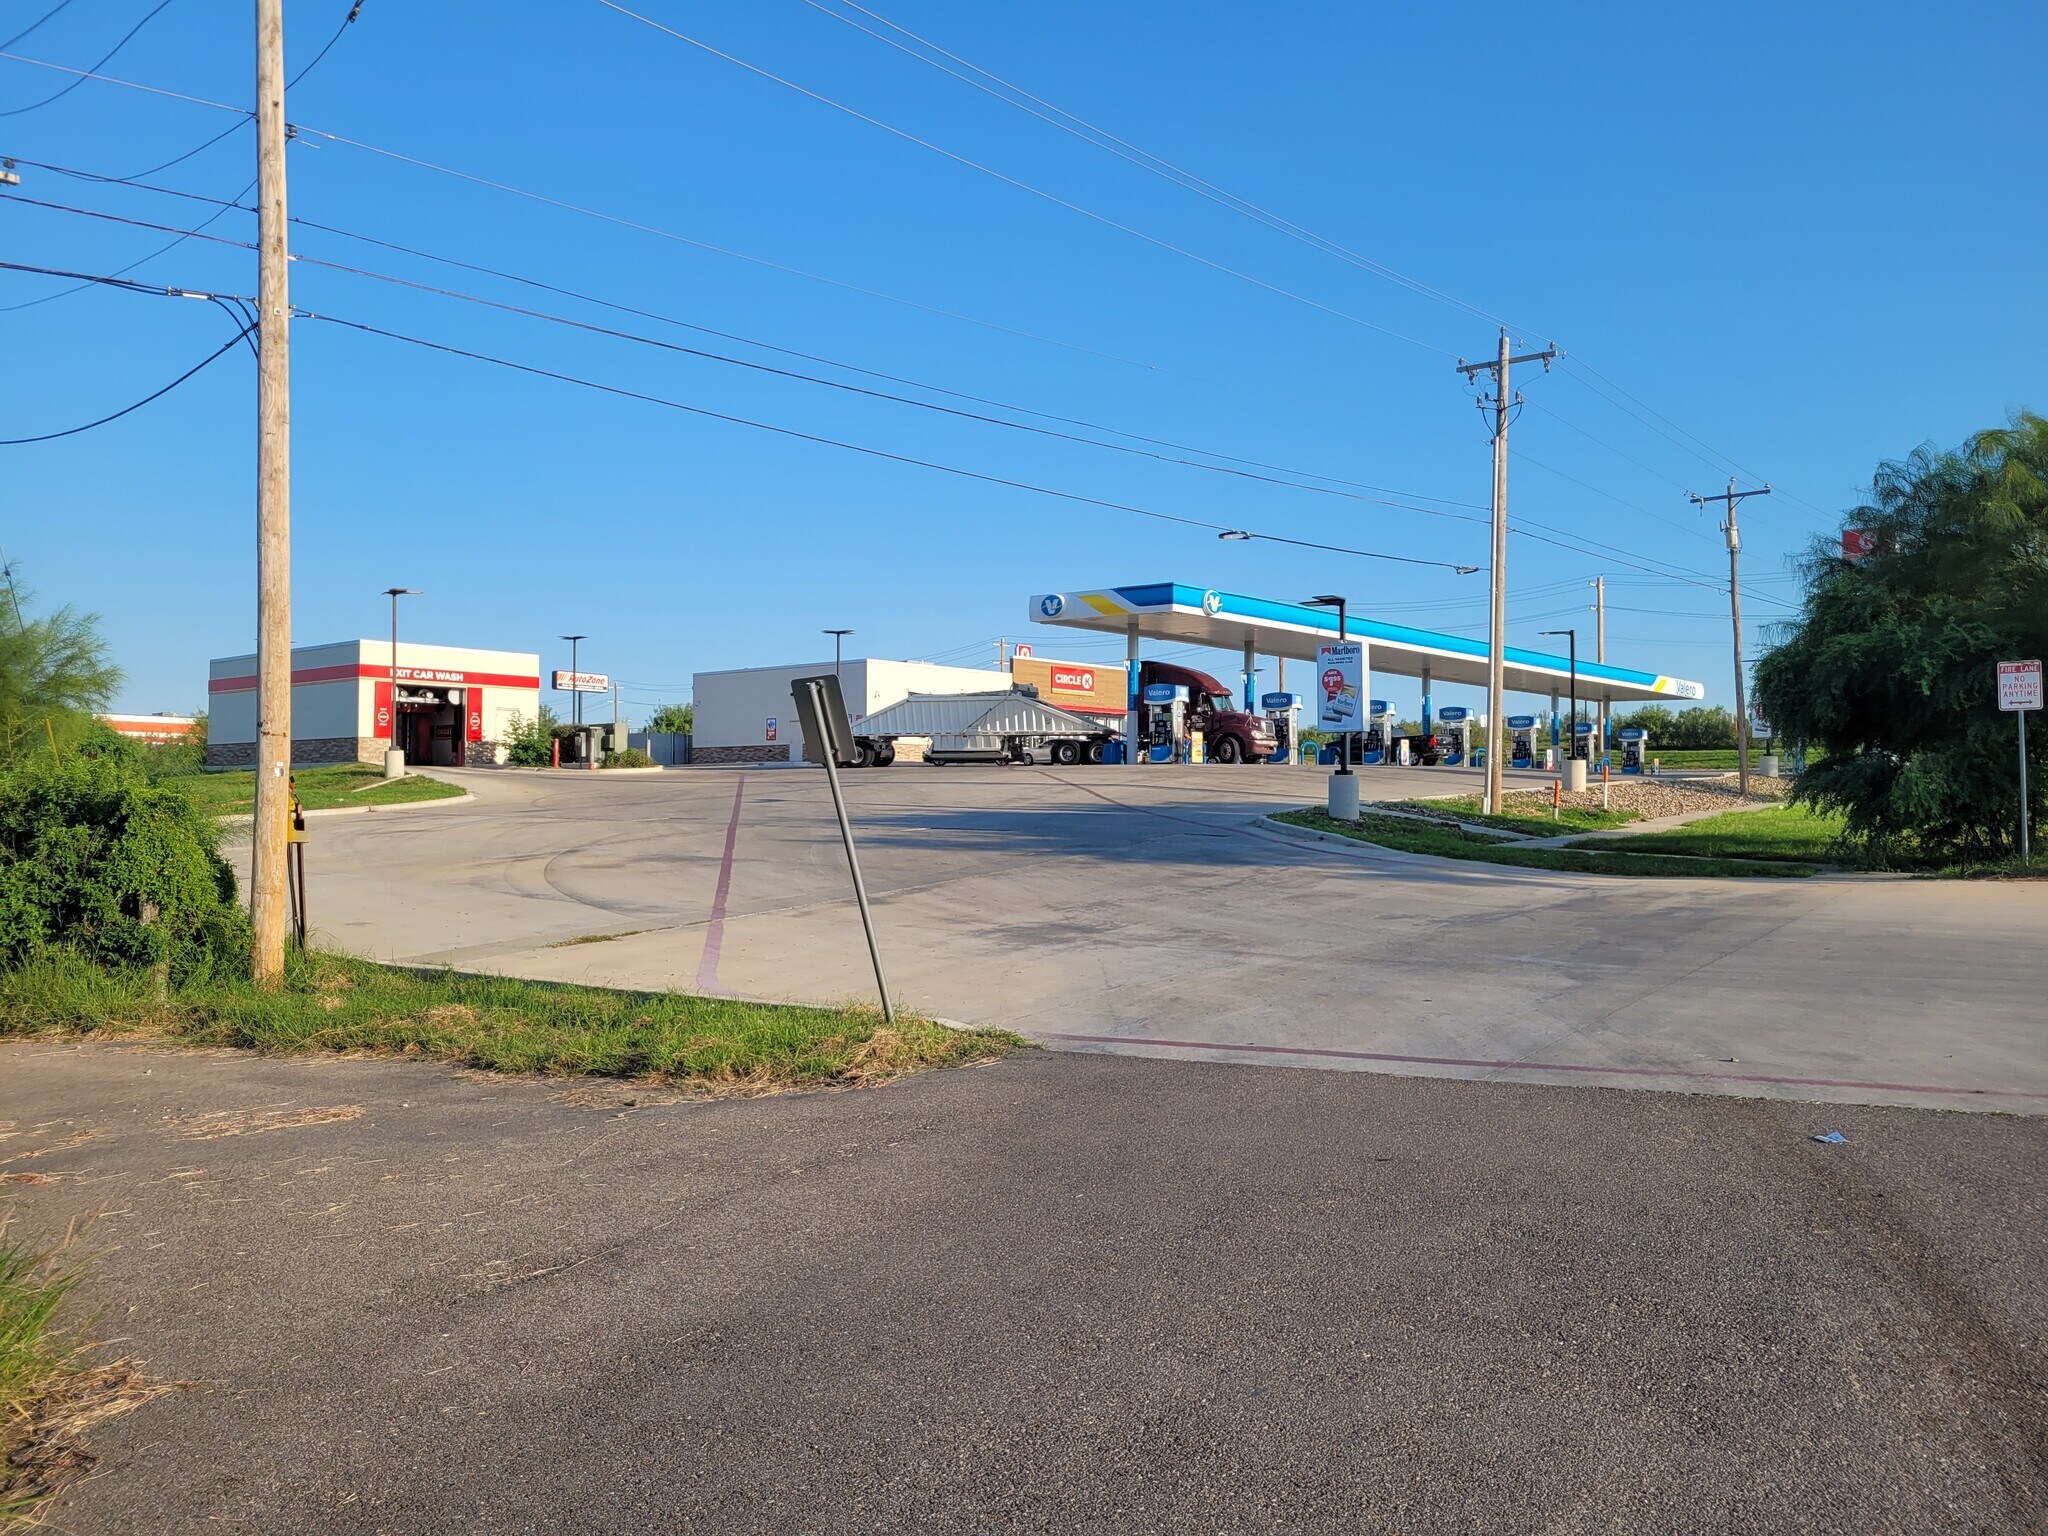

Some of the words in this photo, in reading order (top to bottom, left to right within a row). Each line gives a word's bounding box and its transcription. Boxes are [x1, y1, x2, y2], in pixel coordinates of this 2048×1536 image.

[1332, 646, 1360, 655] Marlboro
[413, 670, 434, 679] CAR
[435, 671, 464, 681] WASH
[569, 675, 605, 684] AutoZone
[1055, 673, 1082, 685] CIRCLE
[1676, 680, 1697, 697] Valero
[2003, 682, 2038, 690] PARKING
[2003, 690, 2038, 698] ANYTIME
